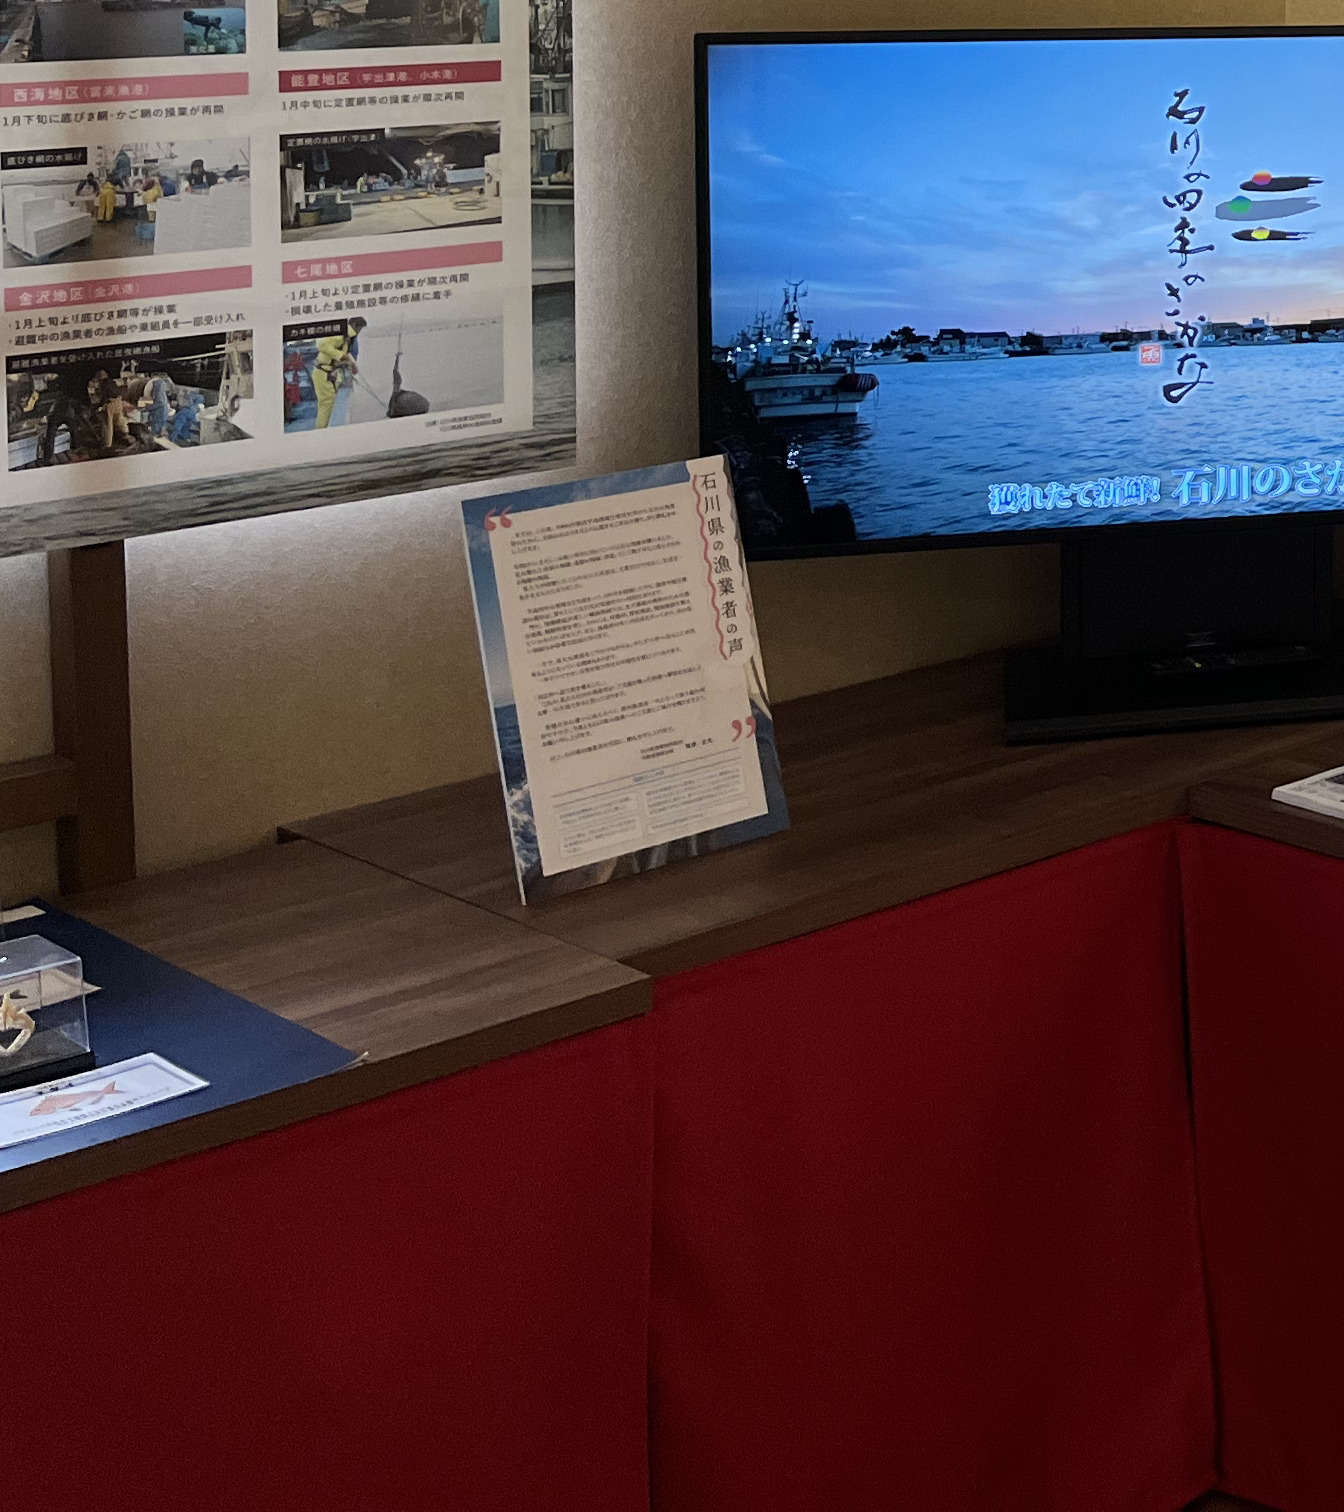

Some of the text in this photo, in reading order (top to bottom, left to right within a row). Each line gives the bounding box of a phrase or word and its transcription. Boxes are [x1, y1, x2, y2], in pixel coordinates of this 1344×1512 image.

[699, 472, 744, 656] 石川県の漁業者の声
